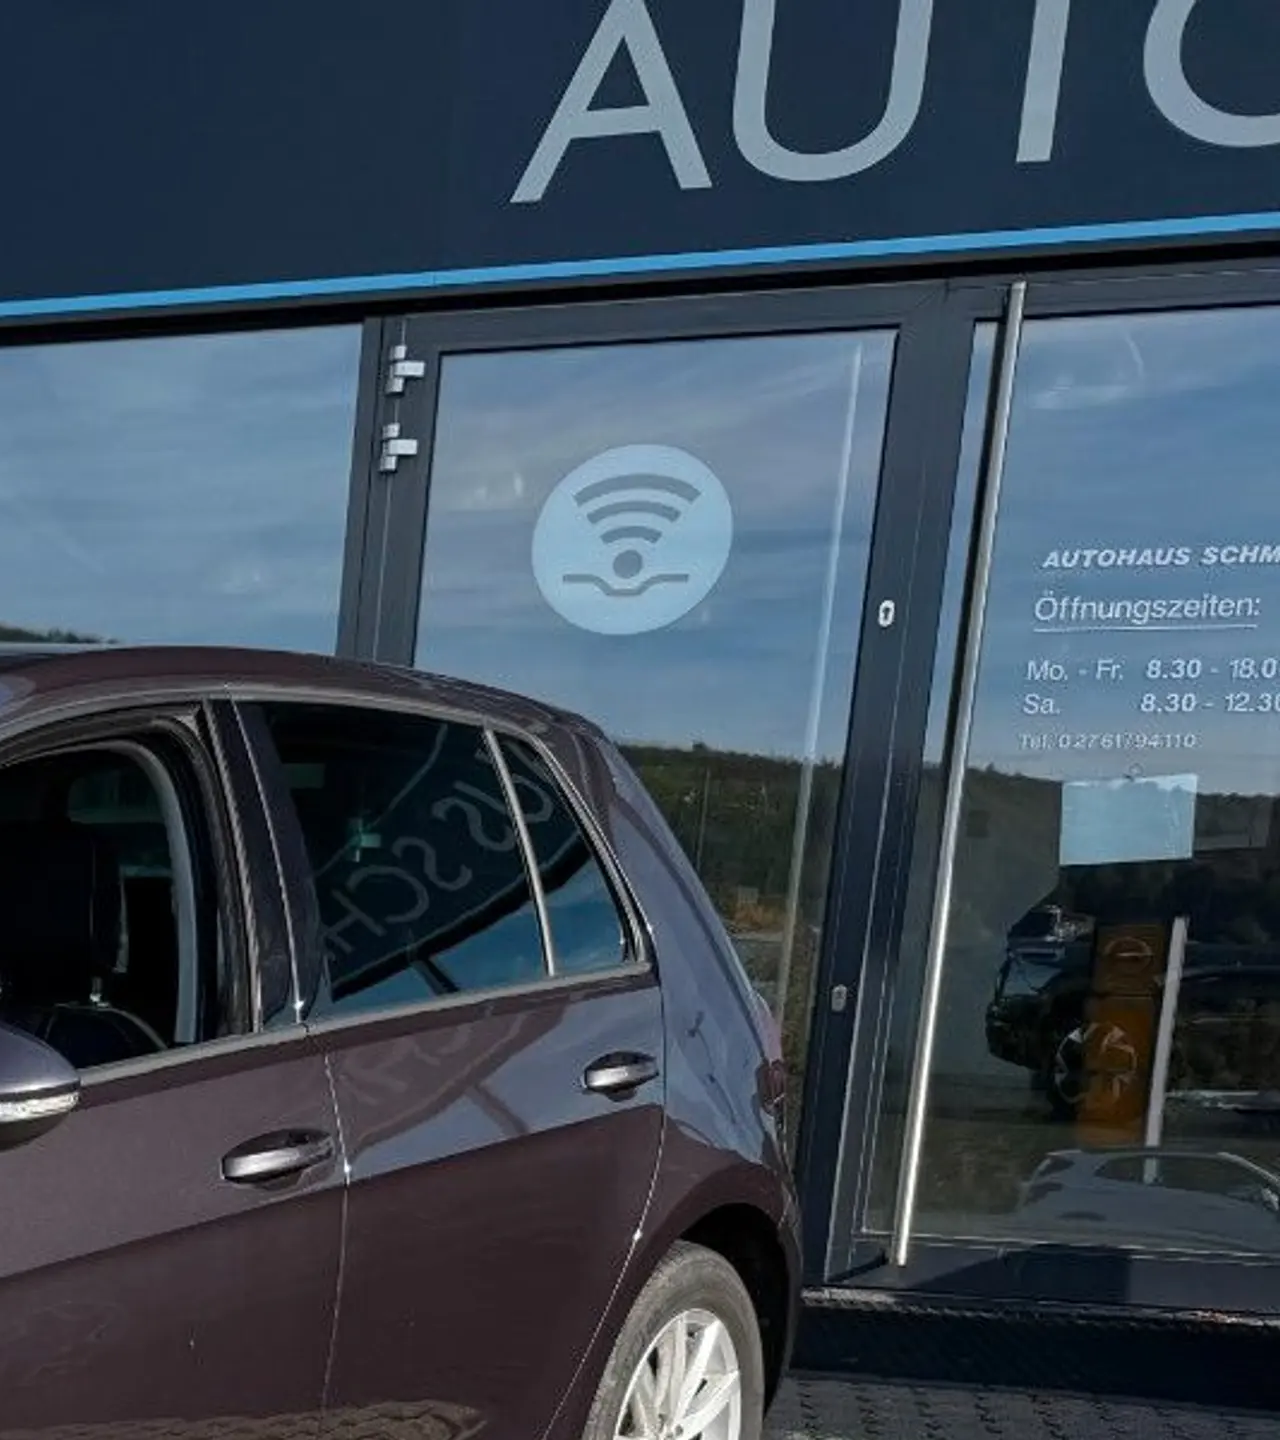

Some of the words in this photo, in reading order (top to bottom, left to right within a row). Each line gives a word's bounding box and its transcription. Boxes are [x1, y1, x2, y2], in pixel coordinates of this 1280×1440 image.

[1042, 547, 1191, 568] AUTOHAUS
[1033, 589, 1262, 625] Öffnungszeiten:
[1027, 659, 1069, 681] Mo.
[1095, 659, 1124, 681] Fr.
[1145, 658, 1202, 679] 8.30
[1229, 657, 1280, 680] 18.0
[1022, 692, 1061, 715] Sa.
[1140, 692, 1197, 712] 8.30
